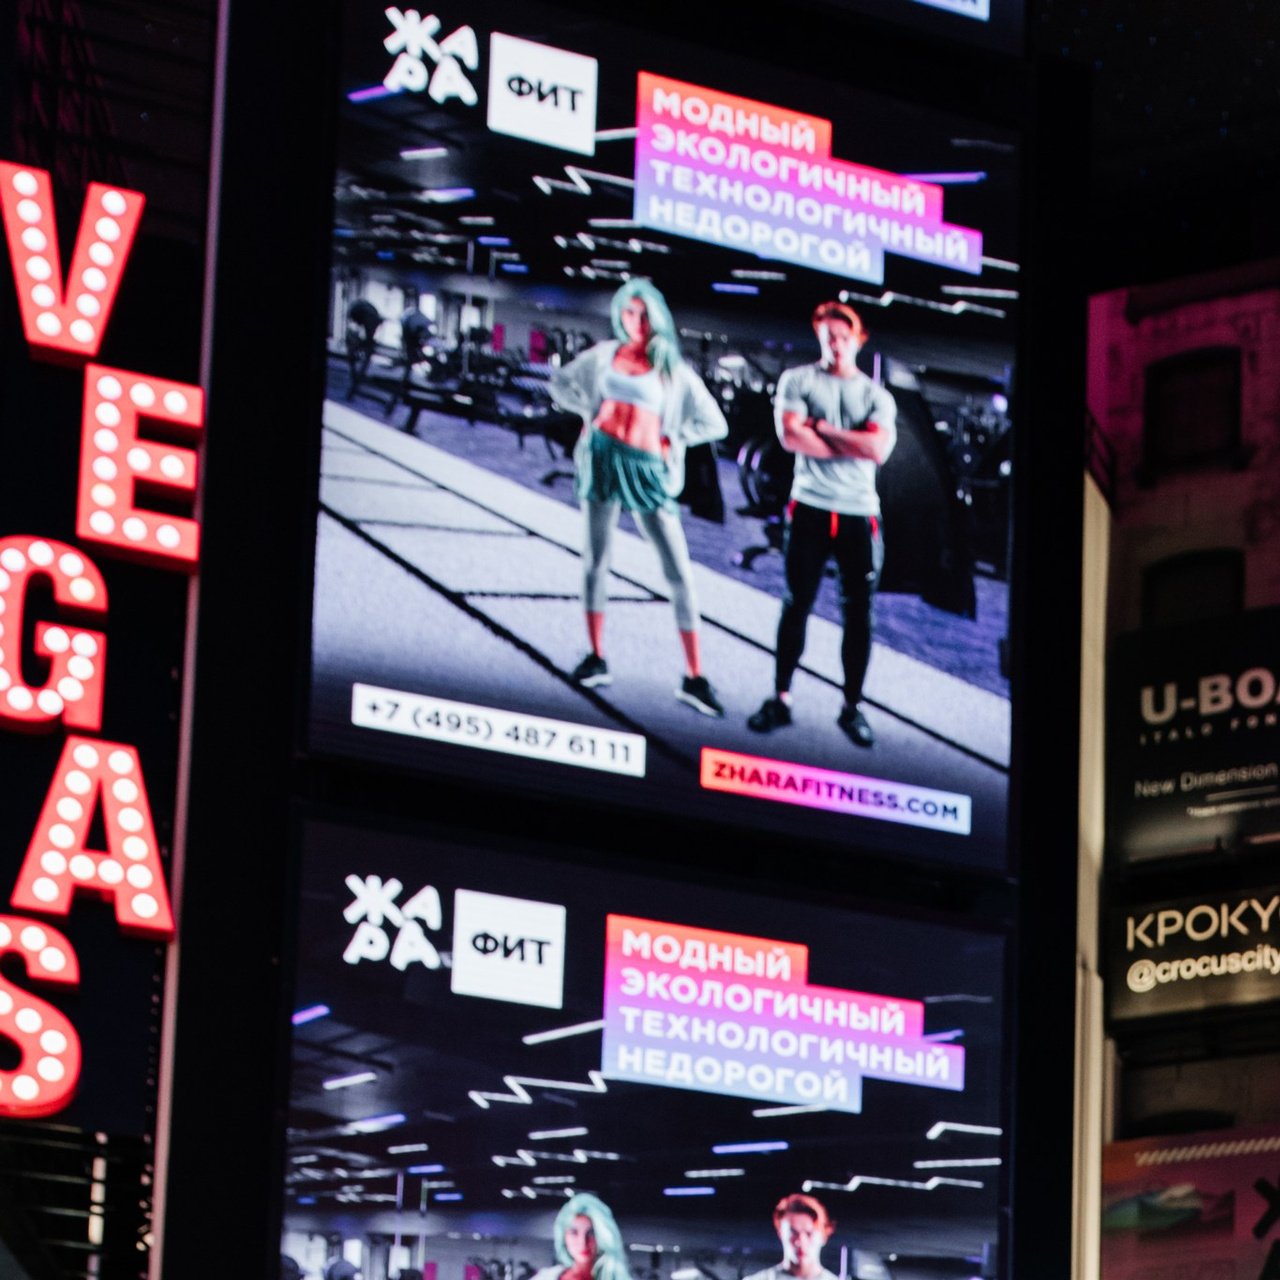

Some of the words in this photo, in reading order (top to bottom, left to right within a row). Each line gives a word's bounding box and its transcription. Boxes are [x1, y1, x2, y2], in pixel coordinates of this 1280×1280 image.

[508, 76, 584, 112] ФИТ
[652, 87, 816, 155] МОДНЫЙ
[649, 124, 927, 218] ЭКОЛОГИЧНЫЙ
[649, 159, 969, 265] ТЕХНОЛОГИЧНЫЙ
[649, 196, 872, 274] НЕДОРОГОЙ
[0, 160, 206, 1118] VEGAS
[366, 700, 400, 721] +7
[412, 707, 493, 741] (495)
[505, 725, 556, 748] 487
[712, 760, 959, 822] ZHARAFITNESS.COM
[1134, 778, 1176, 799] New
[1180, 761, 1278, 792] Dimension
[472, 932, 551, 965] ФИТ
[622, 929, 791, 983] МОДНЫЙ
[620, 967, 906, 1038] ЭКОЛОГИЧНЫЙ
[617, 1044, 849, 1106] НЕДОРОГОЙ
[618, 1005, 950, 1082] ТЕХНОЛОГИЧНЫЙ
